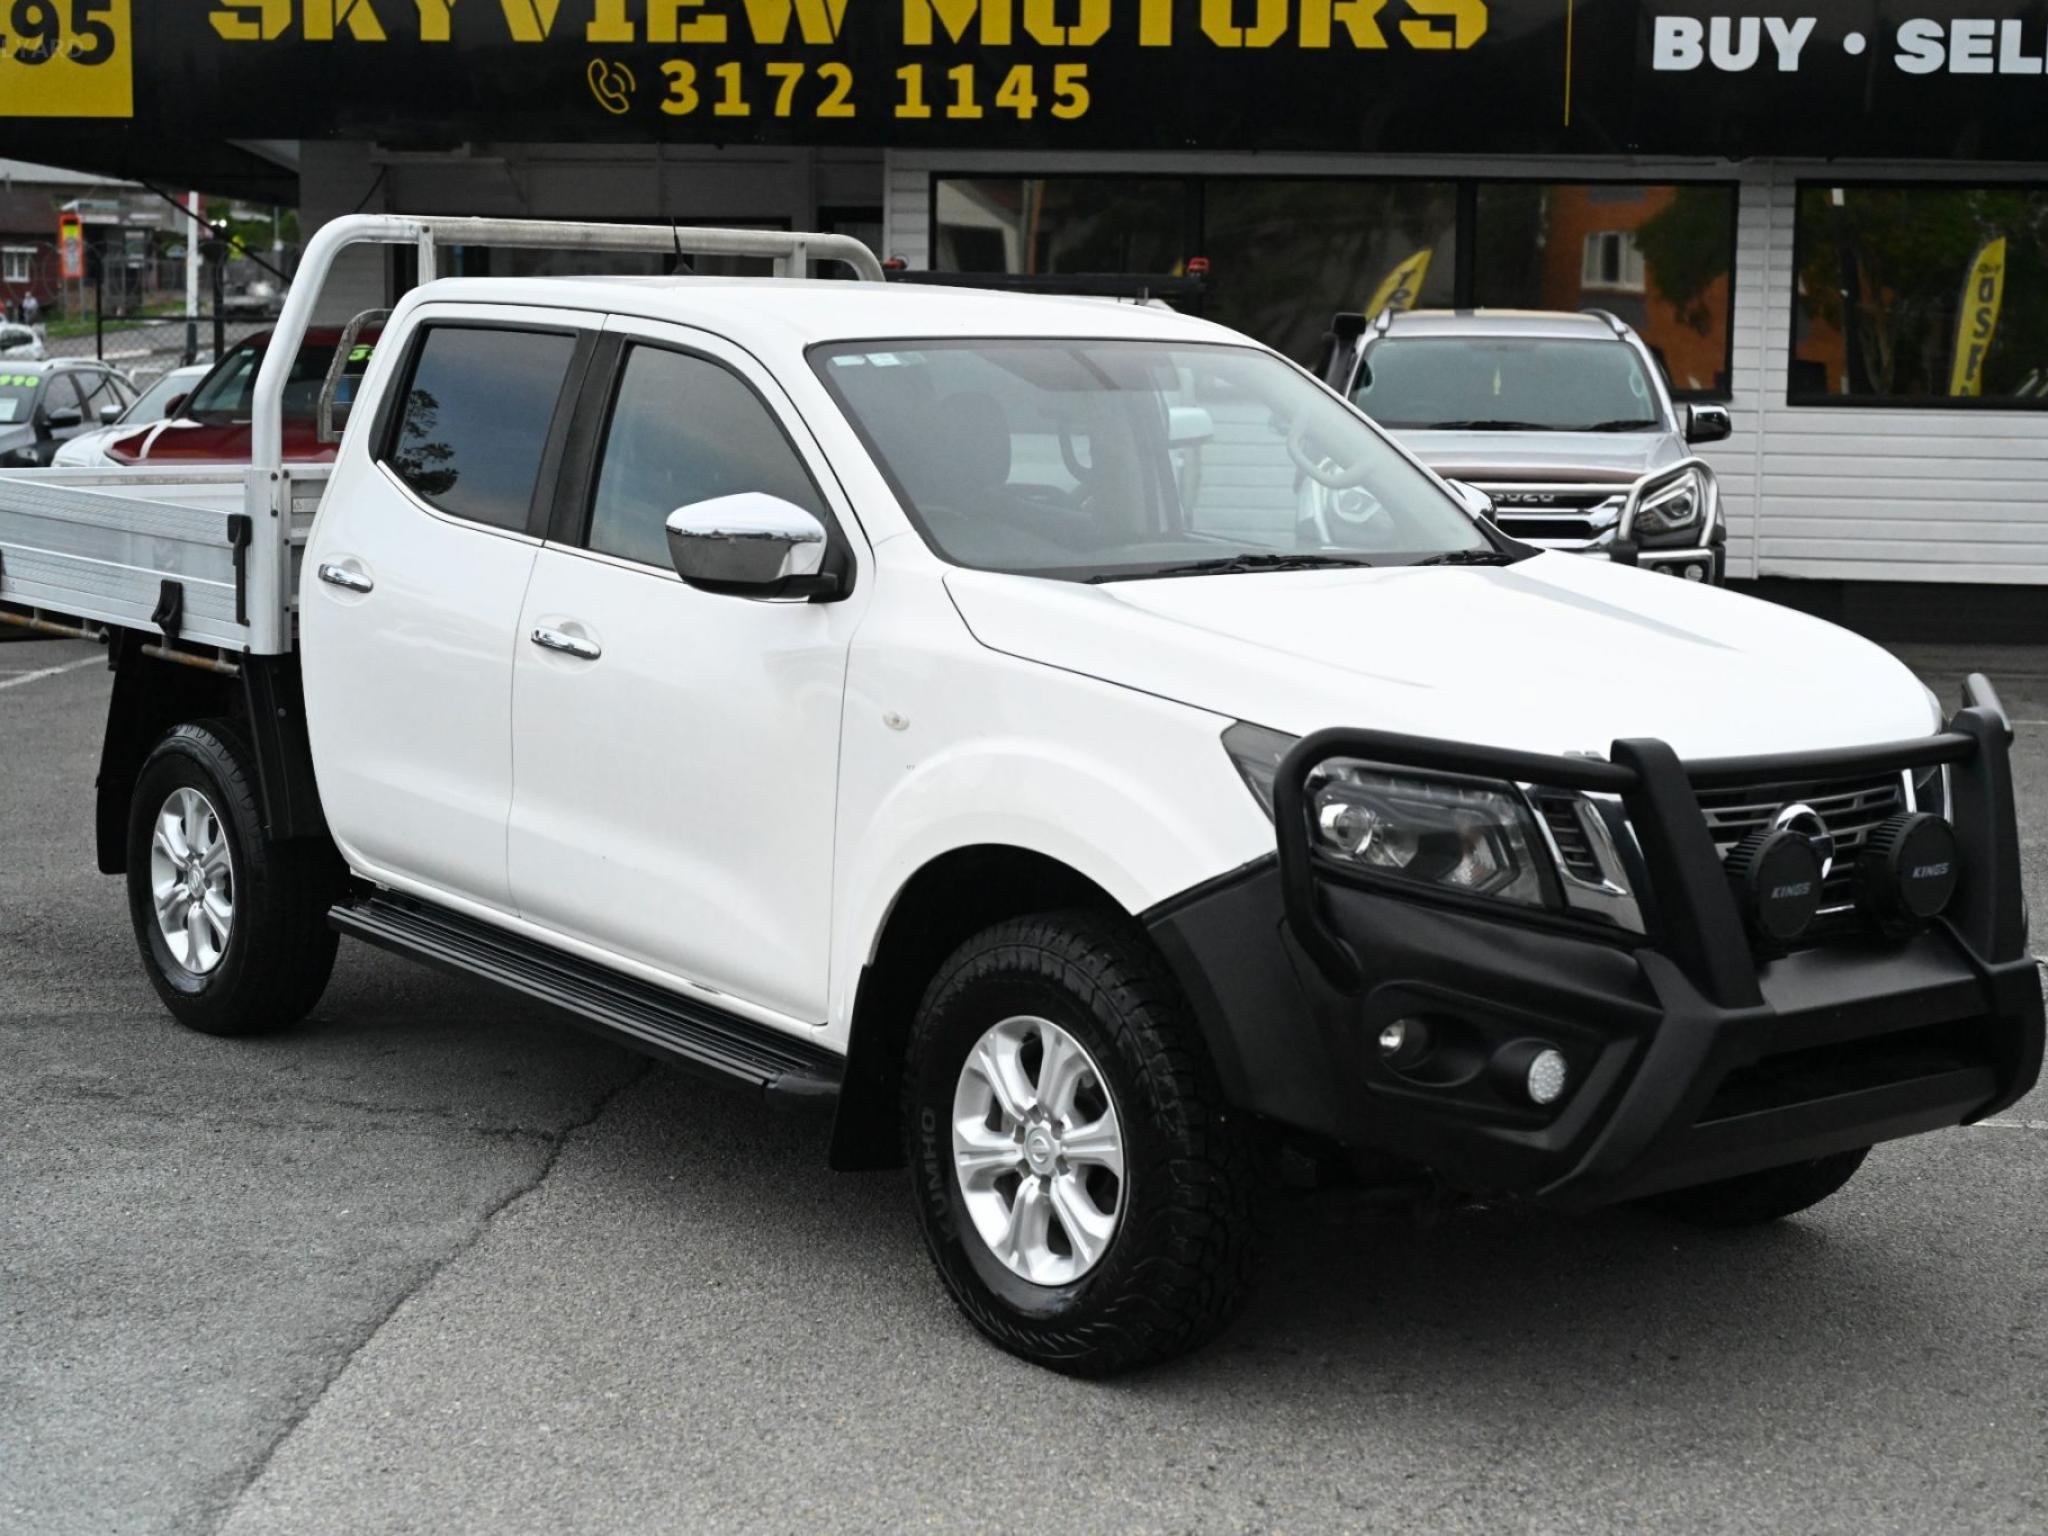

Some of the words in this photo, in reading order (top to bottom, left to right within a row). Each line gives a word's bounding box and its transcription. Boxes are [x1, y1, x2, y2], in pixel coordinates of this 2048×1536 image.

[0, 0, 115, 65] 95
[1653, 16, 1817, 71] BUY
[1894, 18, 2048, 74] SEL
[660, 60, 855, 117] 3172
[895, 64, 1090, 119] 1145
[1771, 882, 1811, 898] KINGS
[1912, 863, 1949, 878] KINGS
